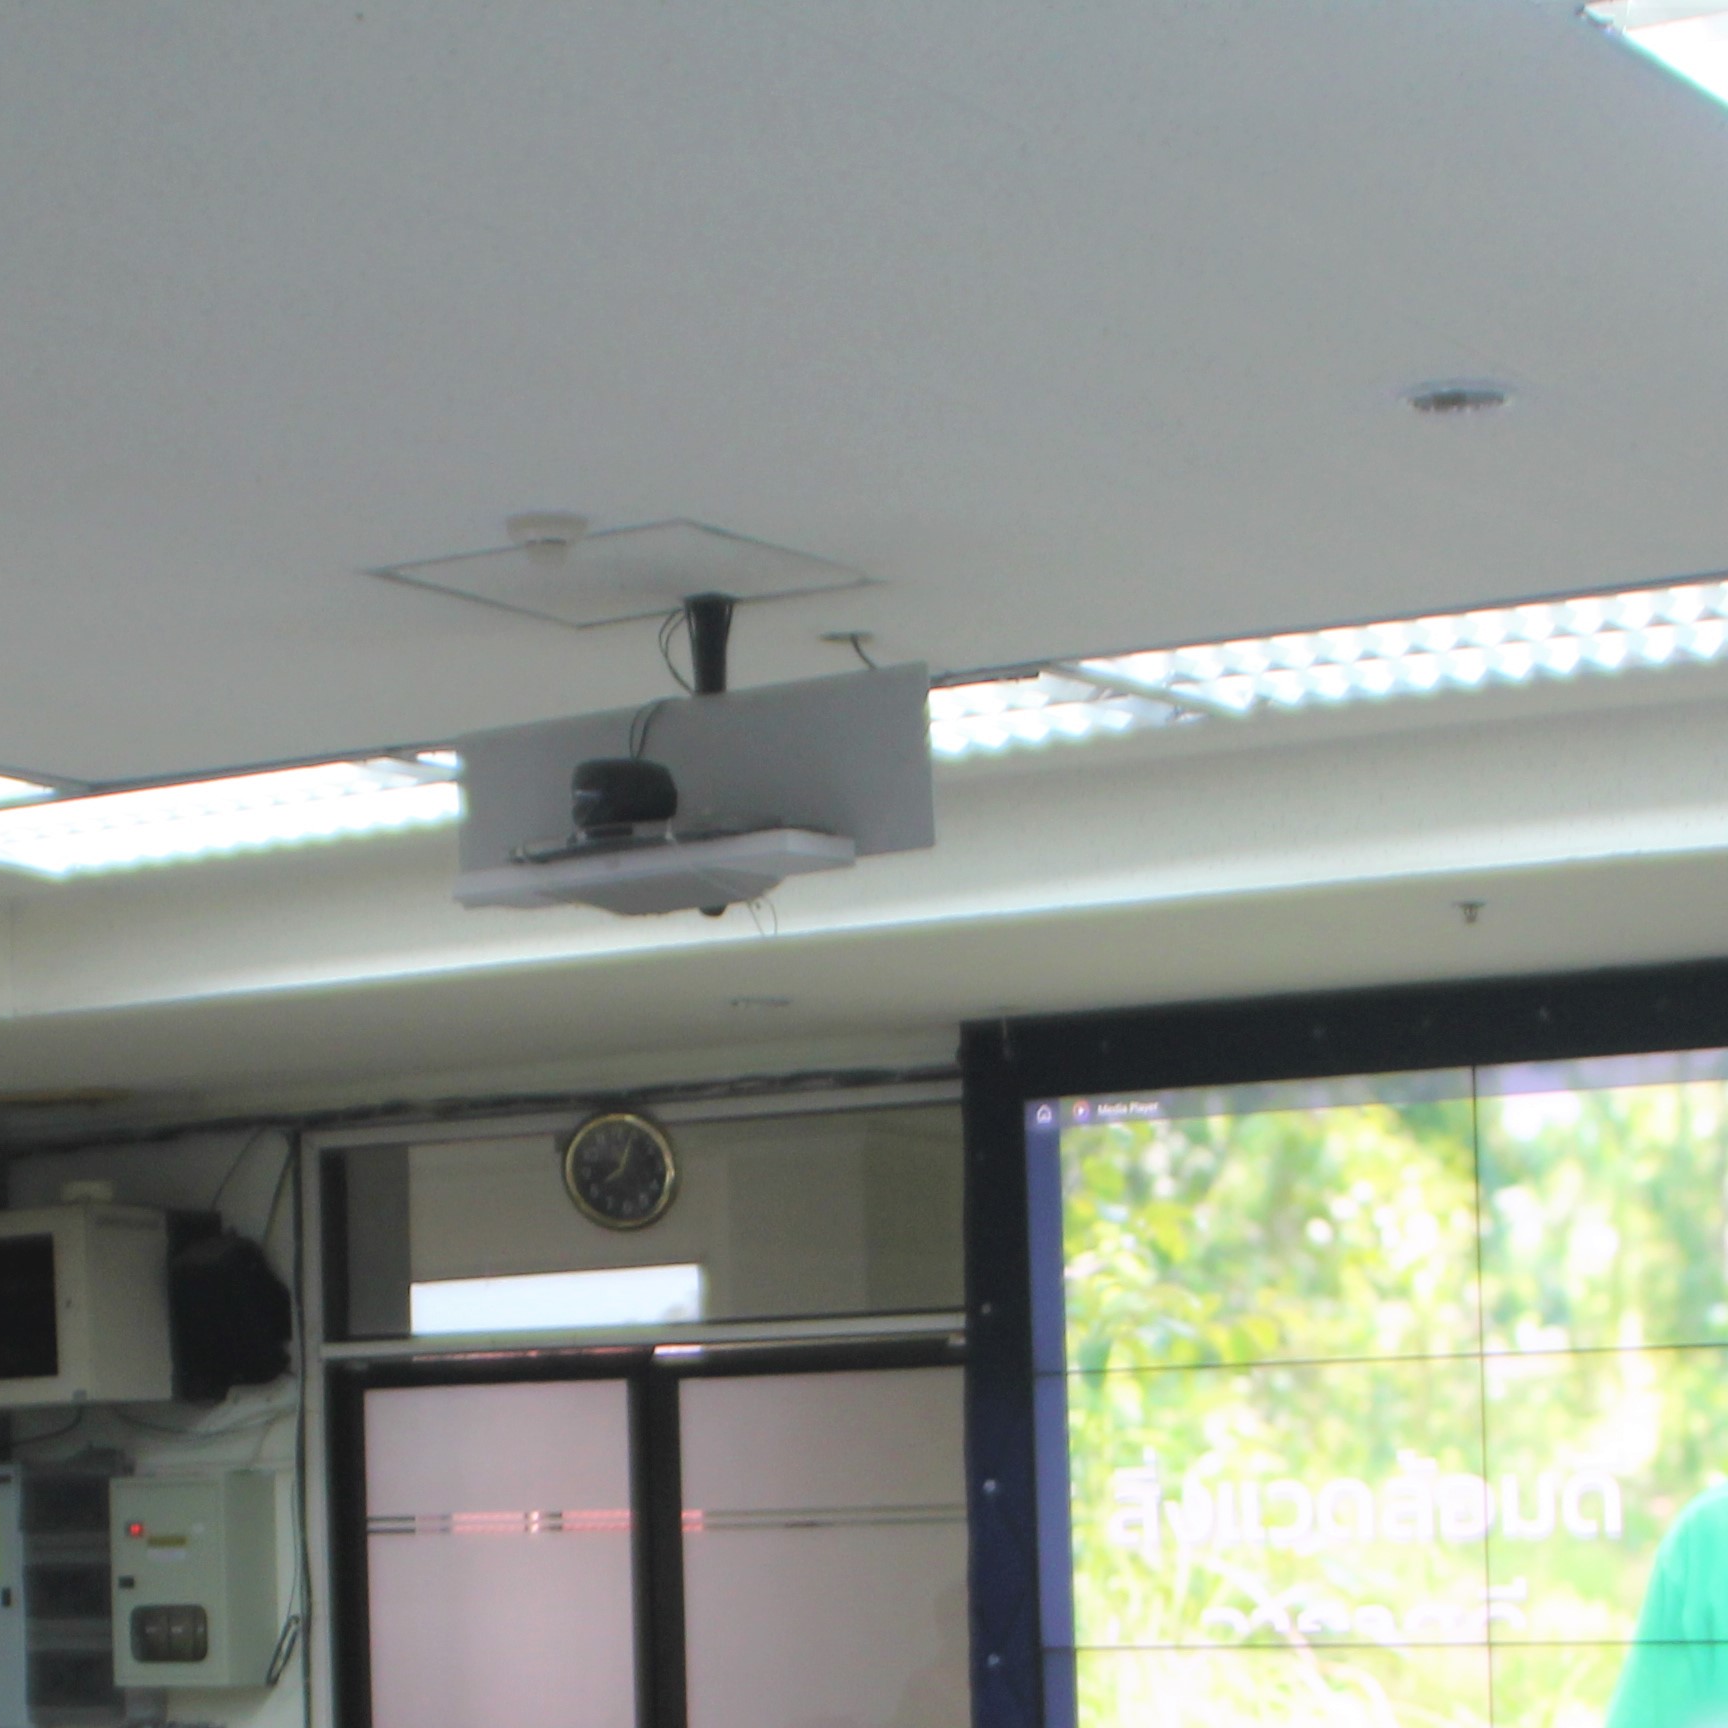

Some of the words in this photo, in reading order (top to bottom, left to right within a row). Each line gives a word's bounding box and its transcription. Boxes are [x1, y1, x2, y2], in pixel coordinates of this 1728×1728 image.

[1098, 1102, 1127, 1116] Media
[1129, 1100, 1159, 1115] Player
[1108, 1449, 1622, 1552] สิ่งแวดล้อมดี
